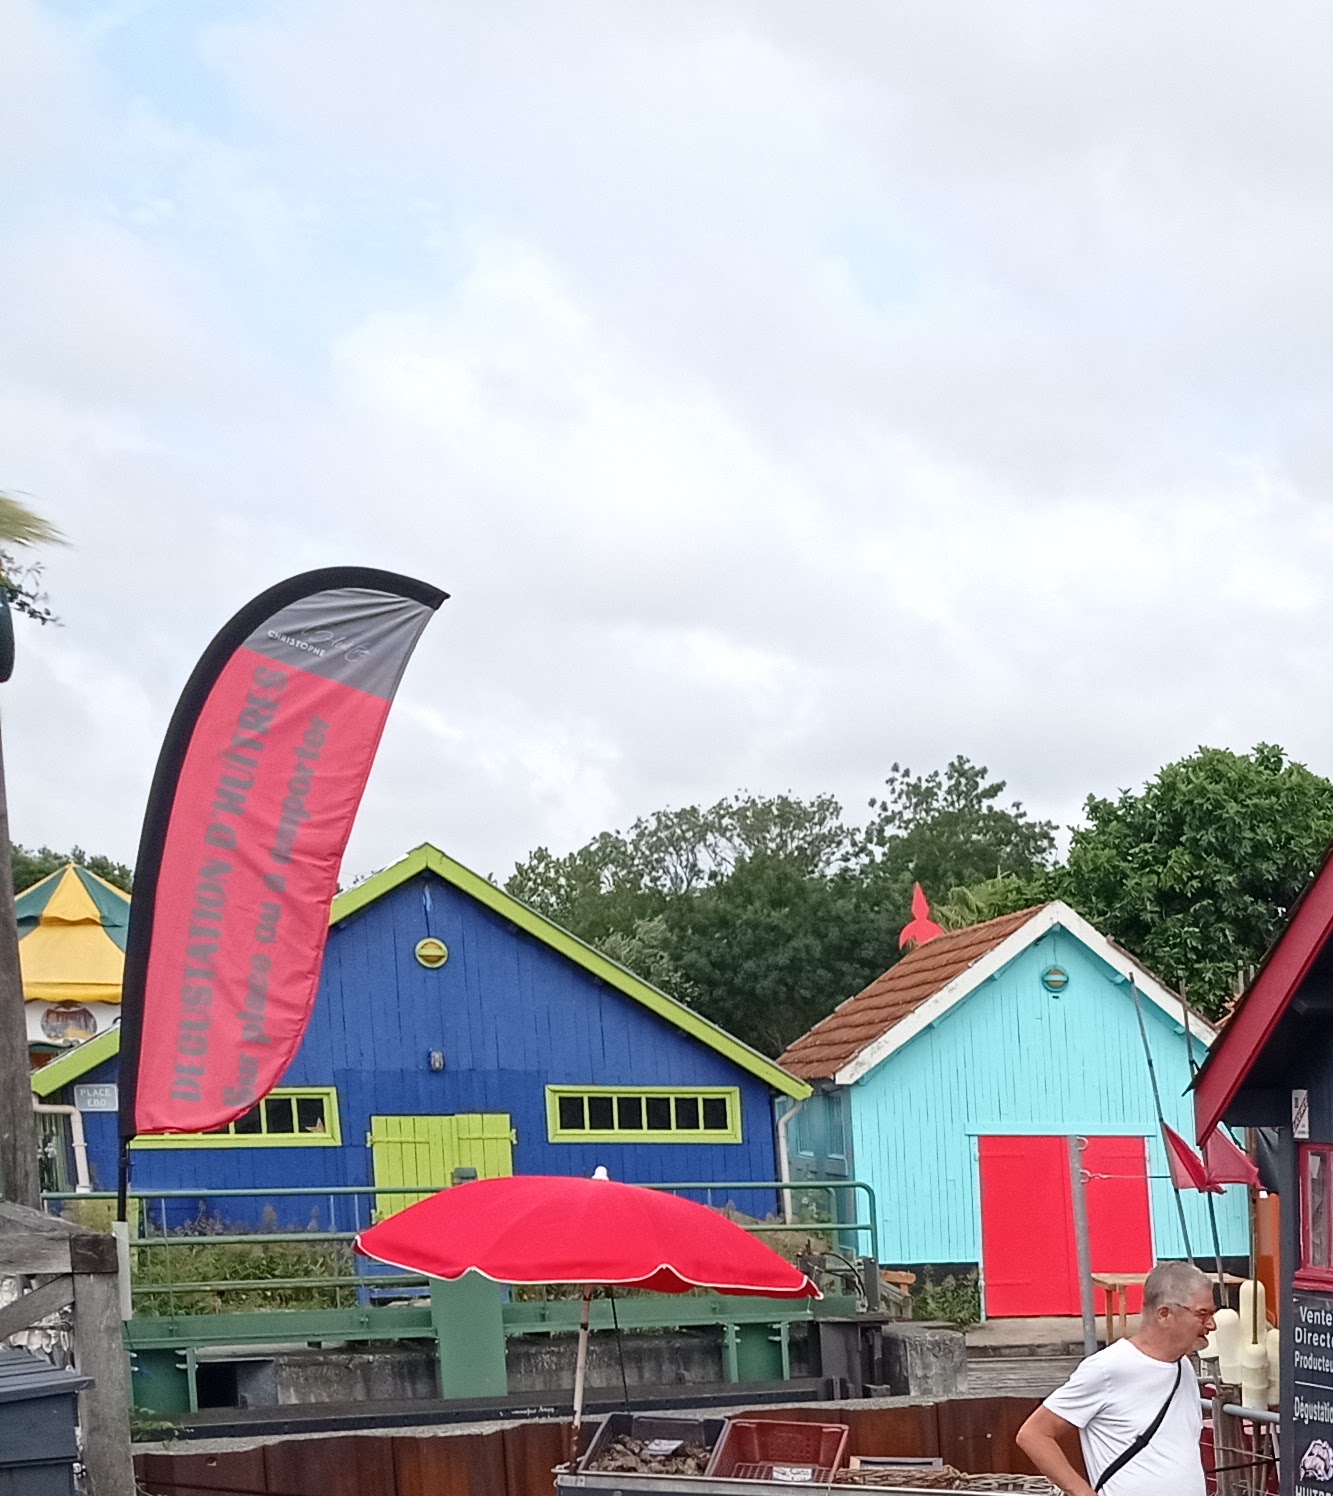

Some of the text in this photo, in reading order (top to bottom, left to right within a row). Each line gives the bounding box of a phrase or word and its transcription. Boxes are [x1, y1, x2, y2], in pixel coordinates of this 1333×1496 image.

[235, 953, 273, 1045] place
[255, 901, 282, 944] ou
[80, 1087, 112, 1097] PLACE
[1300, 1305, 1333, 1327] Vente
